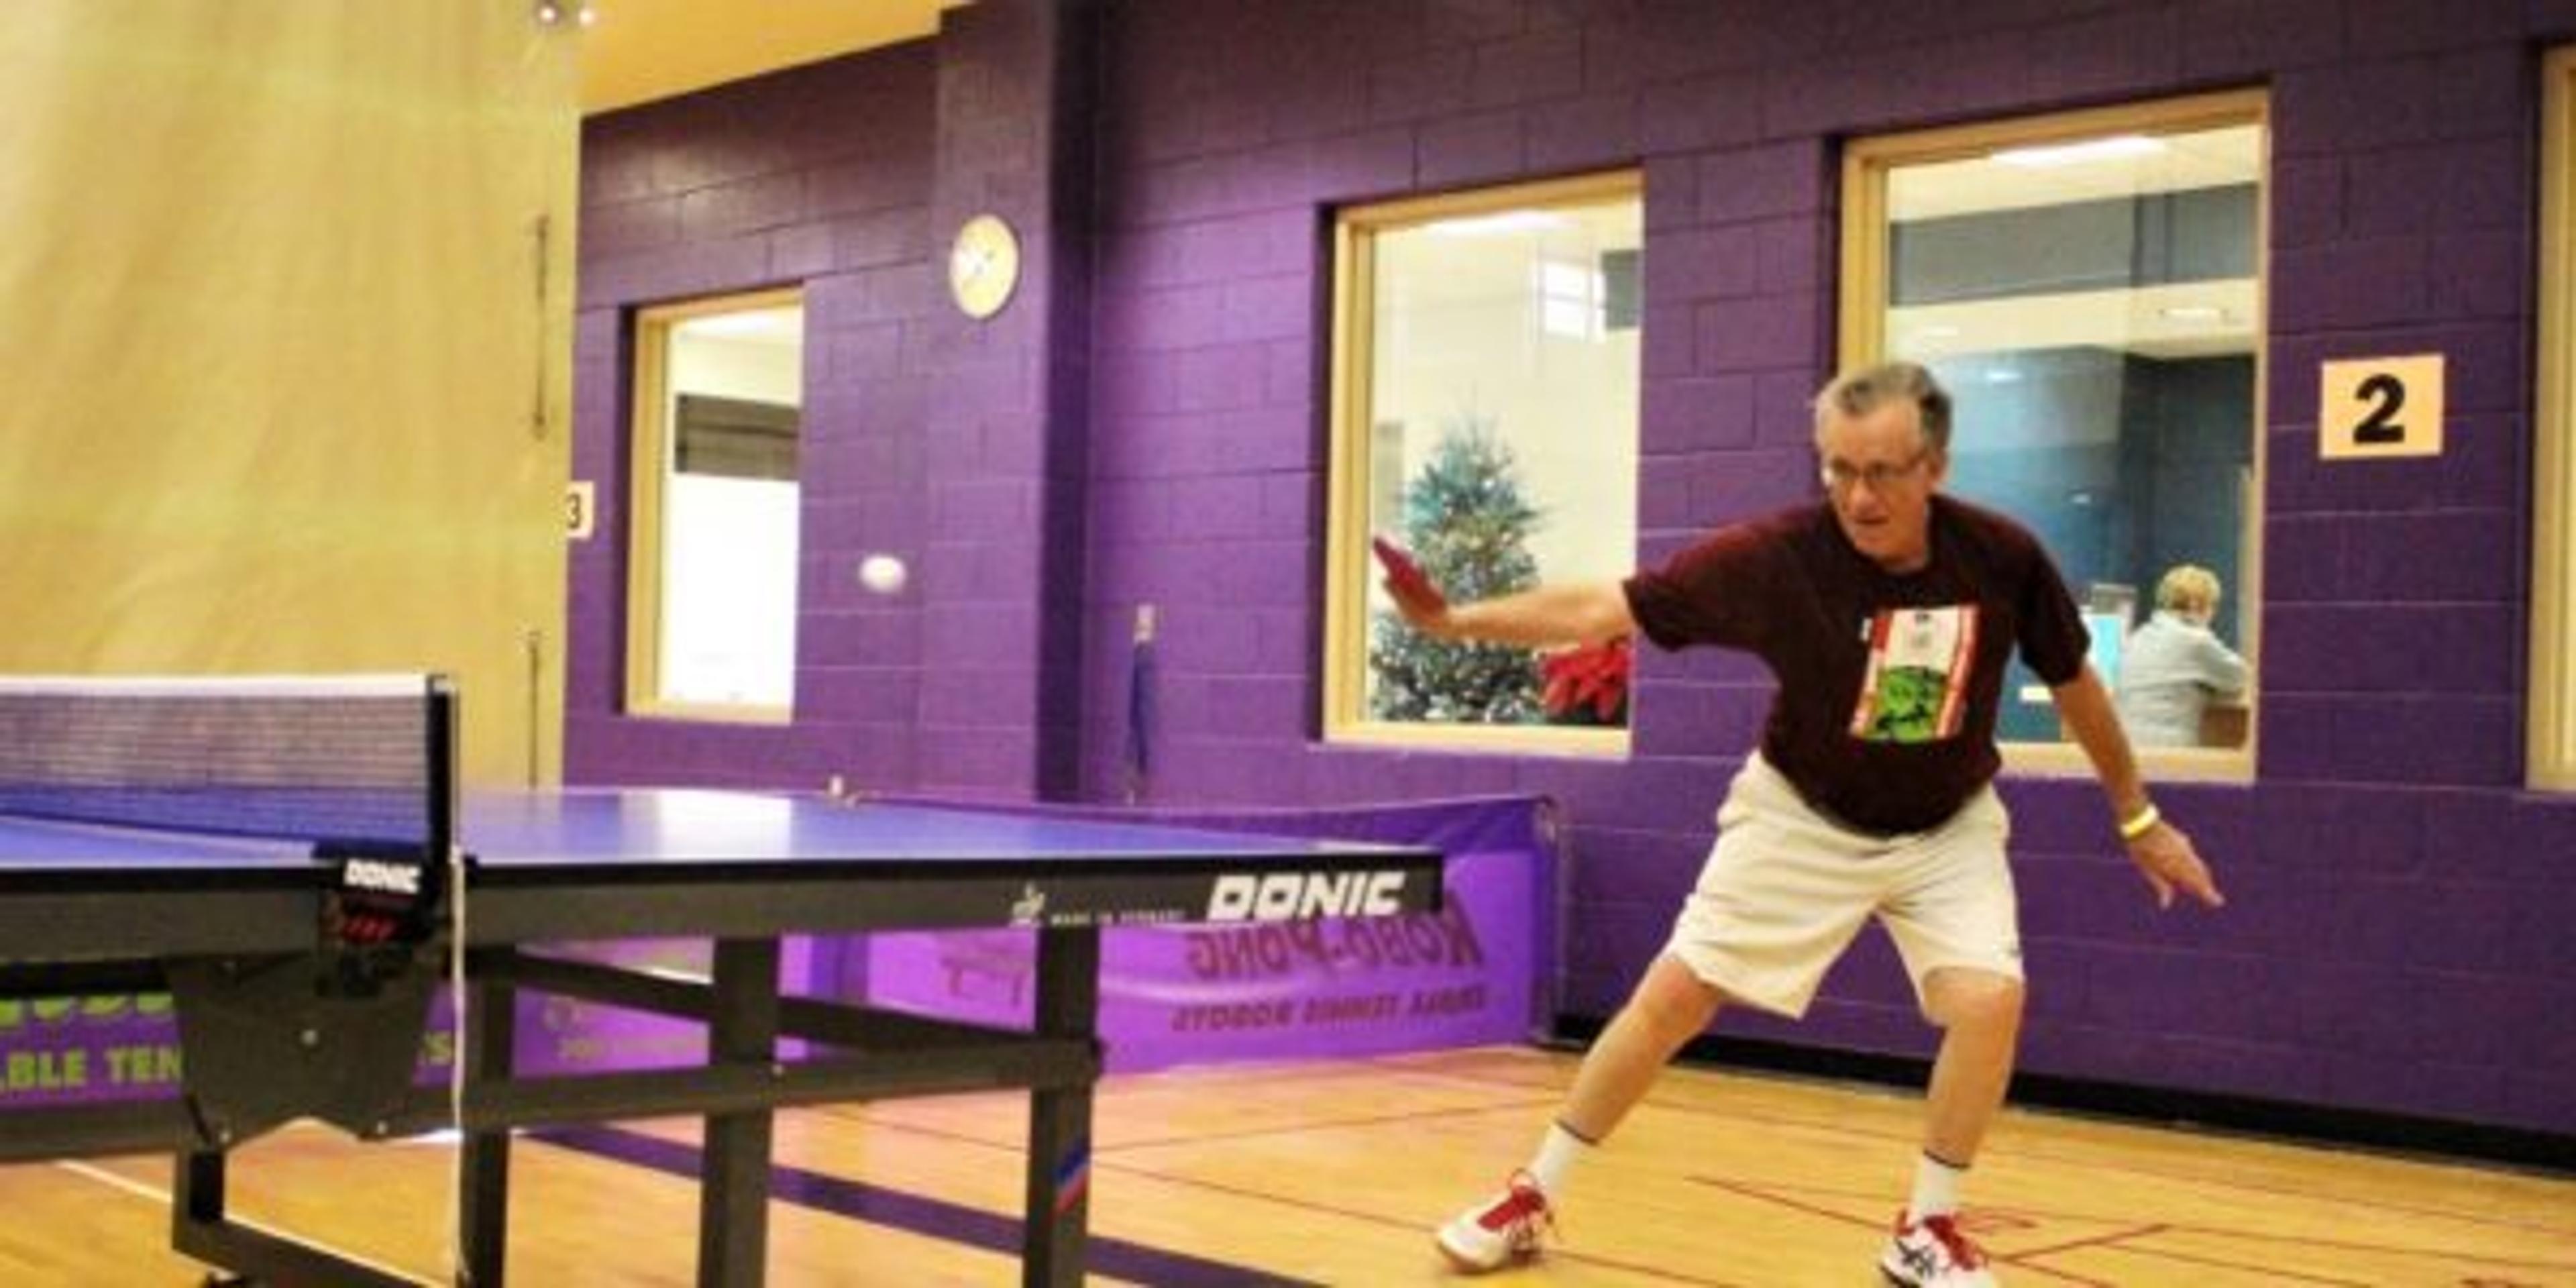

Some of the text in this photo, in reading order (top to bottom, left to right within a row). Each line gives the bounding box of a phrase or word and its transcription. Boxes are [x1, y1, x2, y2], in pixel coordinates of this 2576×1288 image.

[2353, 373, 2406, 445] 2
[566, 493, 582, 530] 3
[343, 858, 421, 894] DONIC
[1208, 871, 1406, 921] DONIC
[0, 1049, 87, 1090] BLE
